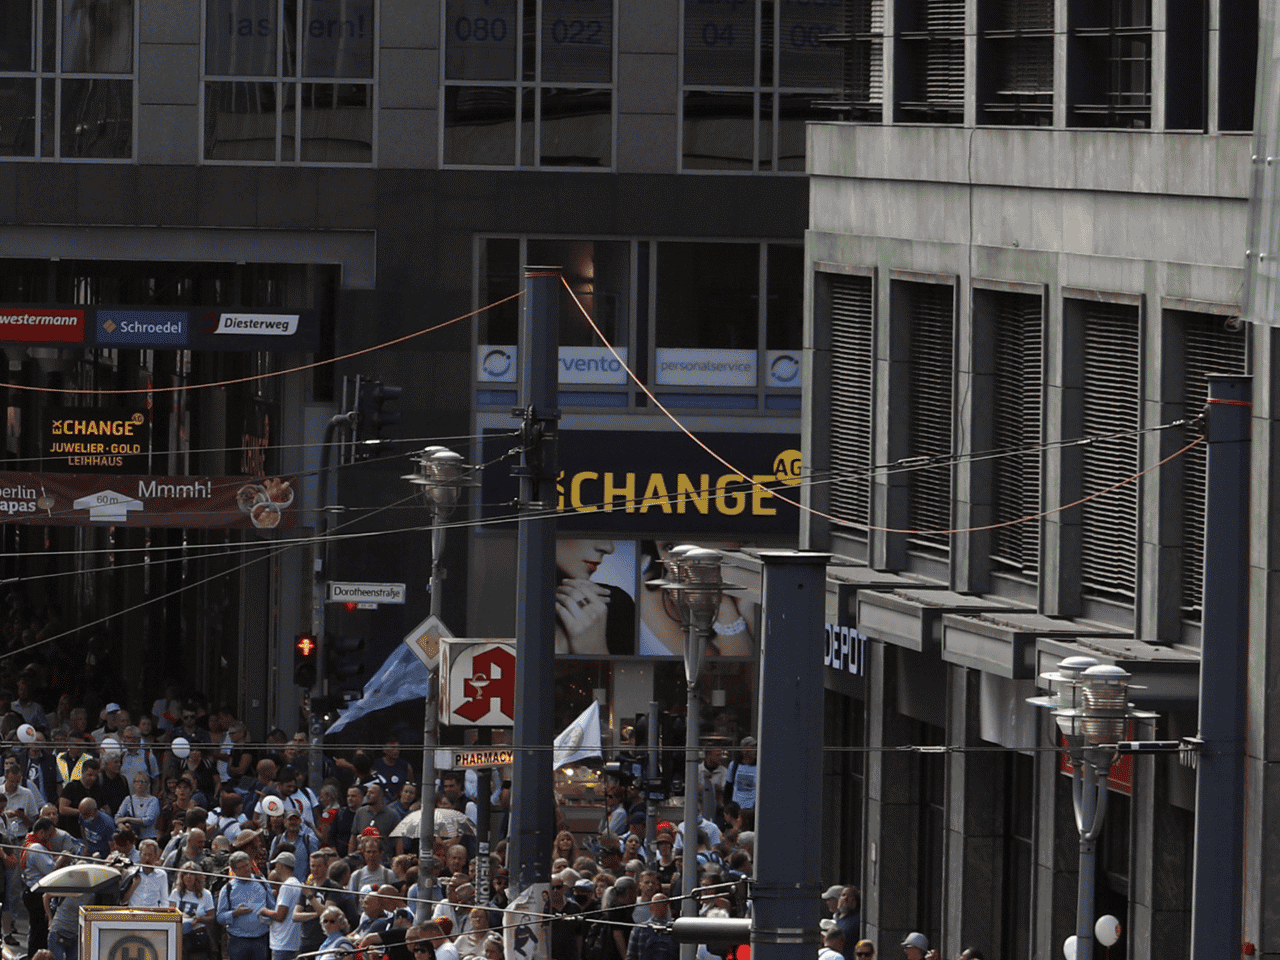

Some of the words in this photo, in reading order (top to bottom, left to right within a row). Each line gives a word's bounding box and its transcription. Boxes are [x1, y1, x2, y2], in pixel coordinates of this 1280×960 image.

[0, 314, 78, 326] westermann
[120, 320, 182, 334] Schroedel
[224, 317, 290, 332] Diesterweg
[68, 455, 123, 466] LEIHHAUS
[138, 481, 211, 499] Mmmh!
[333, 586, 402, 600] Dorotheenstraße
[455, 750, 513, 767] PHARMACY
